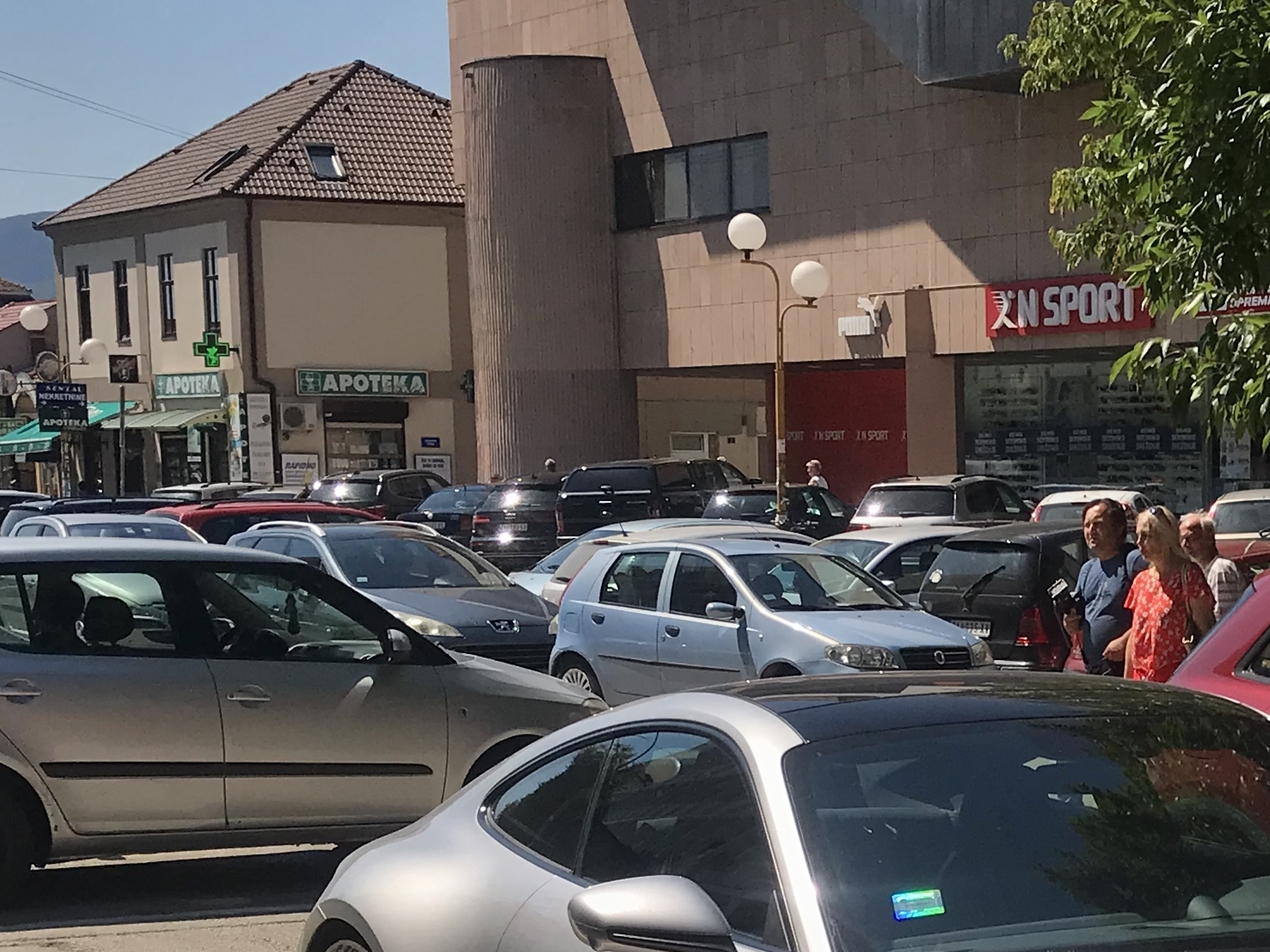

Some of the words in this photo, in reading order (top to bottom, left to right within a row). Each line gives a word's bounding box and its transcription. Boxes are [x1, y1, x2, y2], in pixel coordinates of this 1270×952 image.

[1042, 281, 1143, 327] SPORT
[165, 375, 220, 394] APOTEKA
[322, 373, 426, 394] APOTEKA
[43, 418, 88, 427] APOTEKA
[825, 430, 845, 441] SPORT
[867, 430, 888, 441] SPORT
